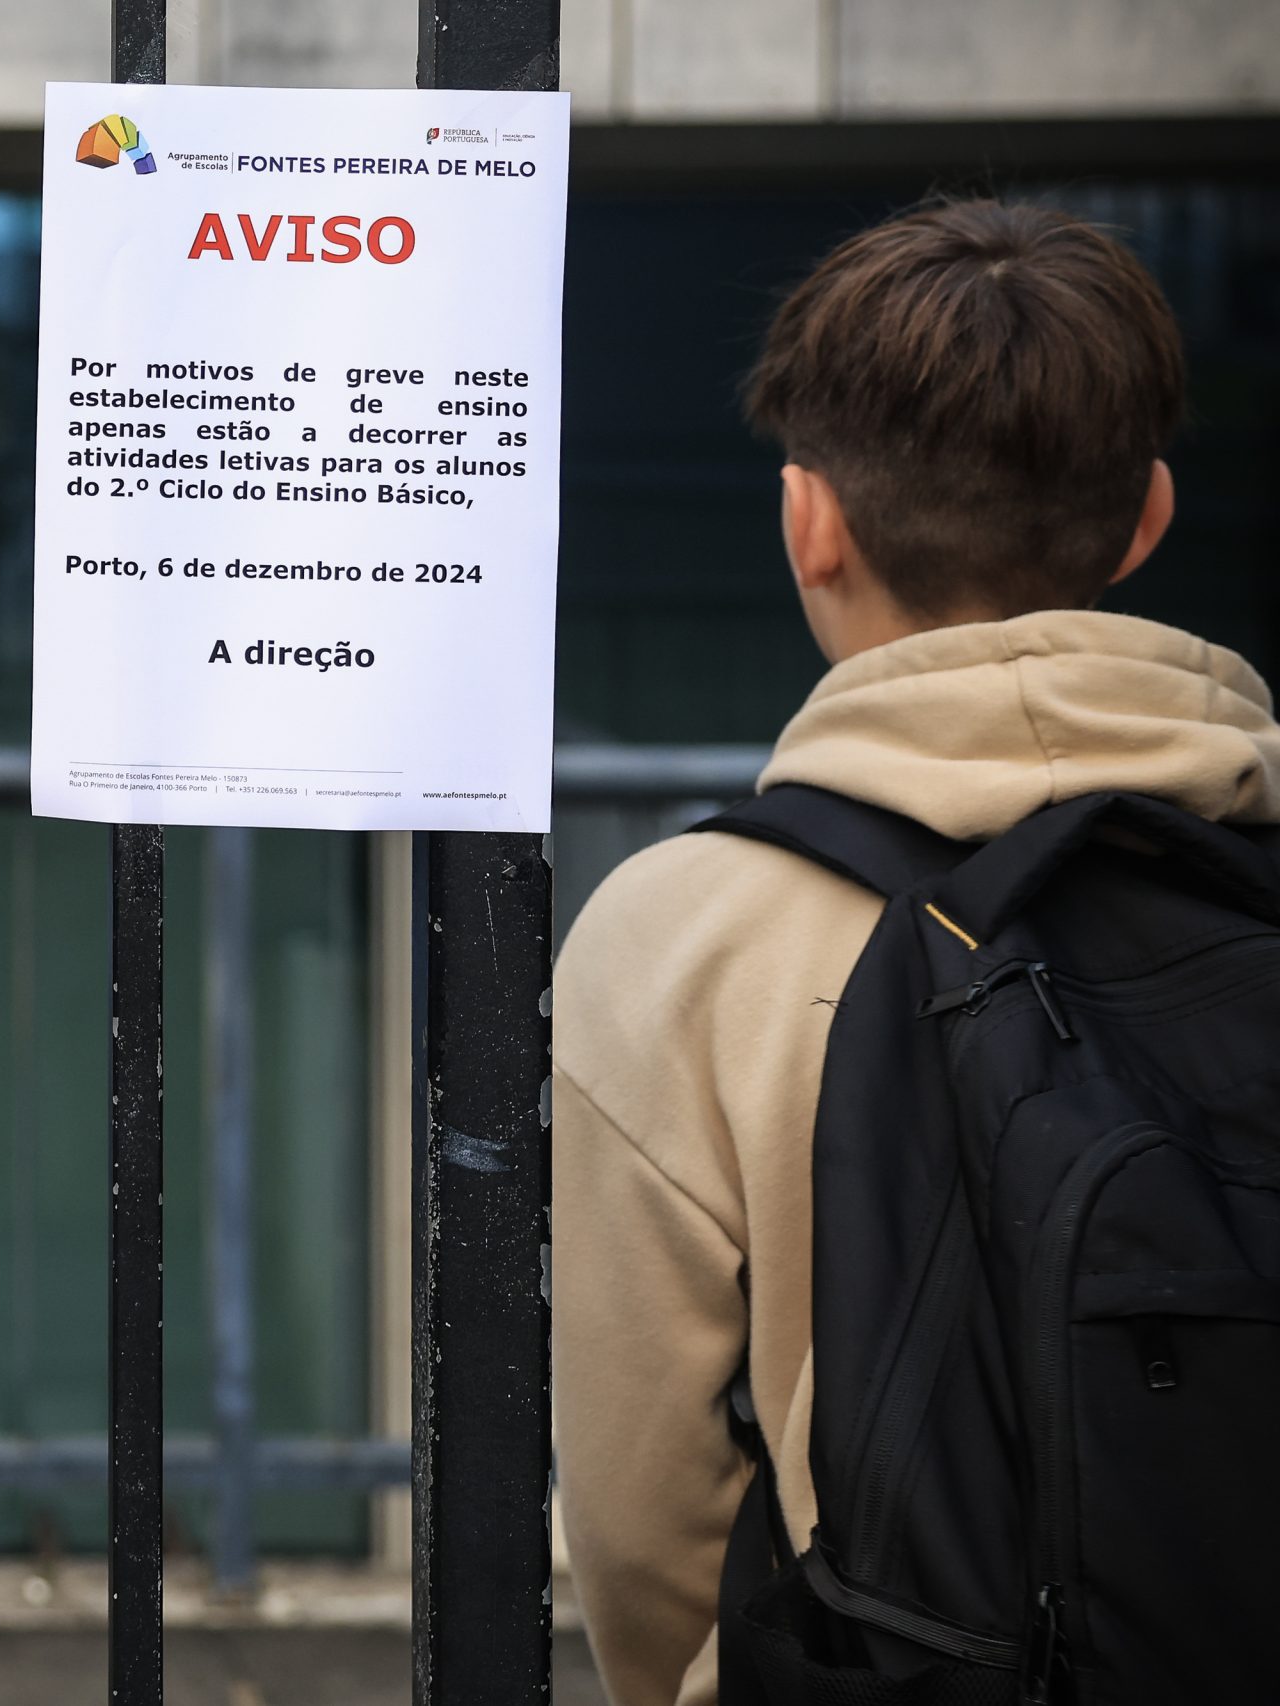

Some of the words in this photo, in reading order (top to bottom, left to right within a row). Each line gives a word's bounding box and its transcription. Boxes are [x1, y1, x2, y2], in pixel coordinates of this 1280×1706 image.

[443, 128, 481, 136] REPÚBLICA
[443, 136, 489, 144] PORTUGUESA
[167, 152, 229, 161] Agrupamento
[195, 162, 228, 171] Escolas
[238, 156, 325, 173] FONTES
[334, 158, 429, 174] PEREIRA
[438, 160, 467, 175] DE
[476, 160, 535, 177] MELO
[188, 213, 415, 264] AVISO
[72, 358, 116, 377] Por
[147, 360, 253, 381] motivos
[284, 363, 315, 382] de
[347, 369, 423, 388] greve
[455, 369, 528, 387] neste
[70, 389, 295, 411] estabelecimento
[350, 394, 382, 413] de
[438, 397, 527, 417] ensino
[69, 422, 165, 441] apenas
[197, 421, 270, 441] estão
[302, 427, 316, 441] a
[349, 424, 467, 445] decorrer
[498, 432, 526, 447] as
[68, 448, 208, 469] atividades
[220, 451, 309, 471] letivas
[322, 458, 381, 476] para
[395, 459, 424, 474] os
[437, 456, 525, 476] alunos
[67, 477, 99, 496] do
[111, 478, 148, 497] 2.º
[160, 479, 222, 499] Ciclo
[233, 481, 265, 500] do
[277, 482, 366, 502] Ensino
[378, 483, 473, 509] Básico,
[66, 556, 146, 580] Porto,
[158, 558, 173, 576] 6
[184, 558, 215, 577] de
[225, 559, 361, 581] dezembro
[372, 563, 404, 582] de
[415, 564, 482, 583] 2024
[208, 640, 231, 663] A
[245, 640, 374, 672] direção
[69, 770, 114, 780] Agrupamento
[125, 772, 150, 781] Escolas
[151, 773, 174, 781] Fontes
[175, 773, 199, 782] Pereira
[200, 774, 217, 782] Melo
[223, 775, 248, 783] 150873
[69, 780, 82, 788] Rua
[90, 781, 118, 790] Primeiro
[119, 782, 128, 790] de
[156, 783, 188, 792] 4100-366
[189, 784, 208, 792] Porto
[226, 785, 237, 793] Tel.
[238, 785, 255, 794] +351
[422, 791, 507, 800] www.aefontespmelo.pt
